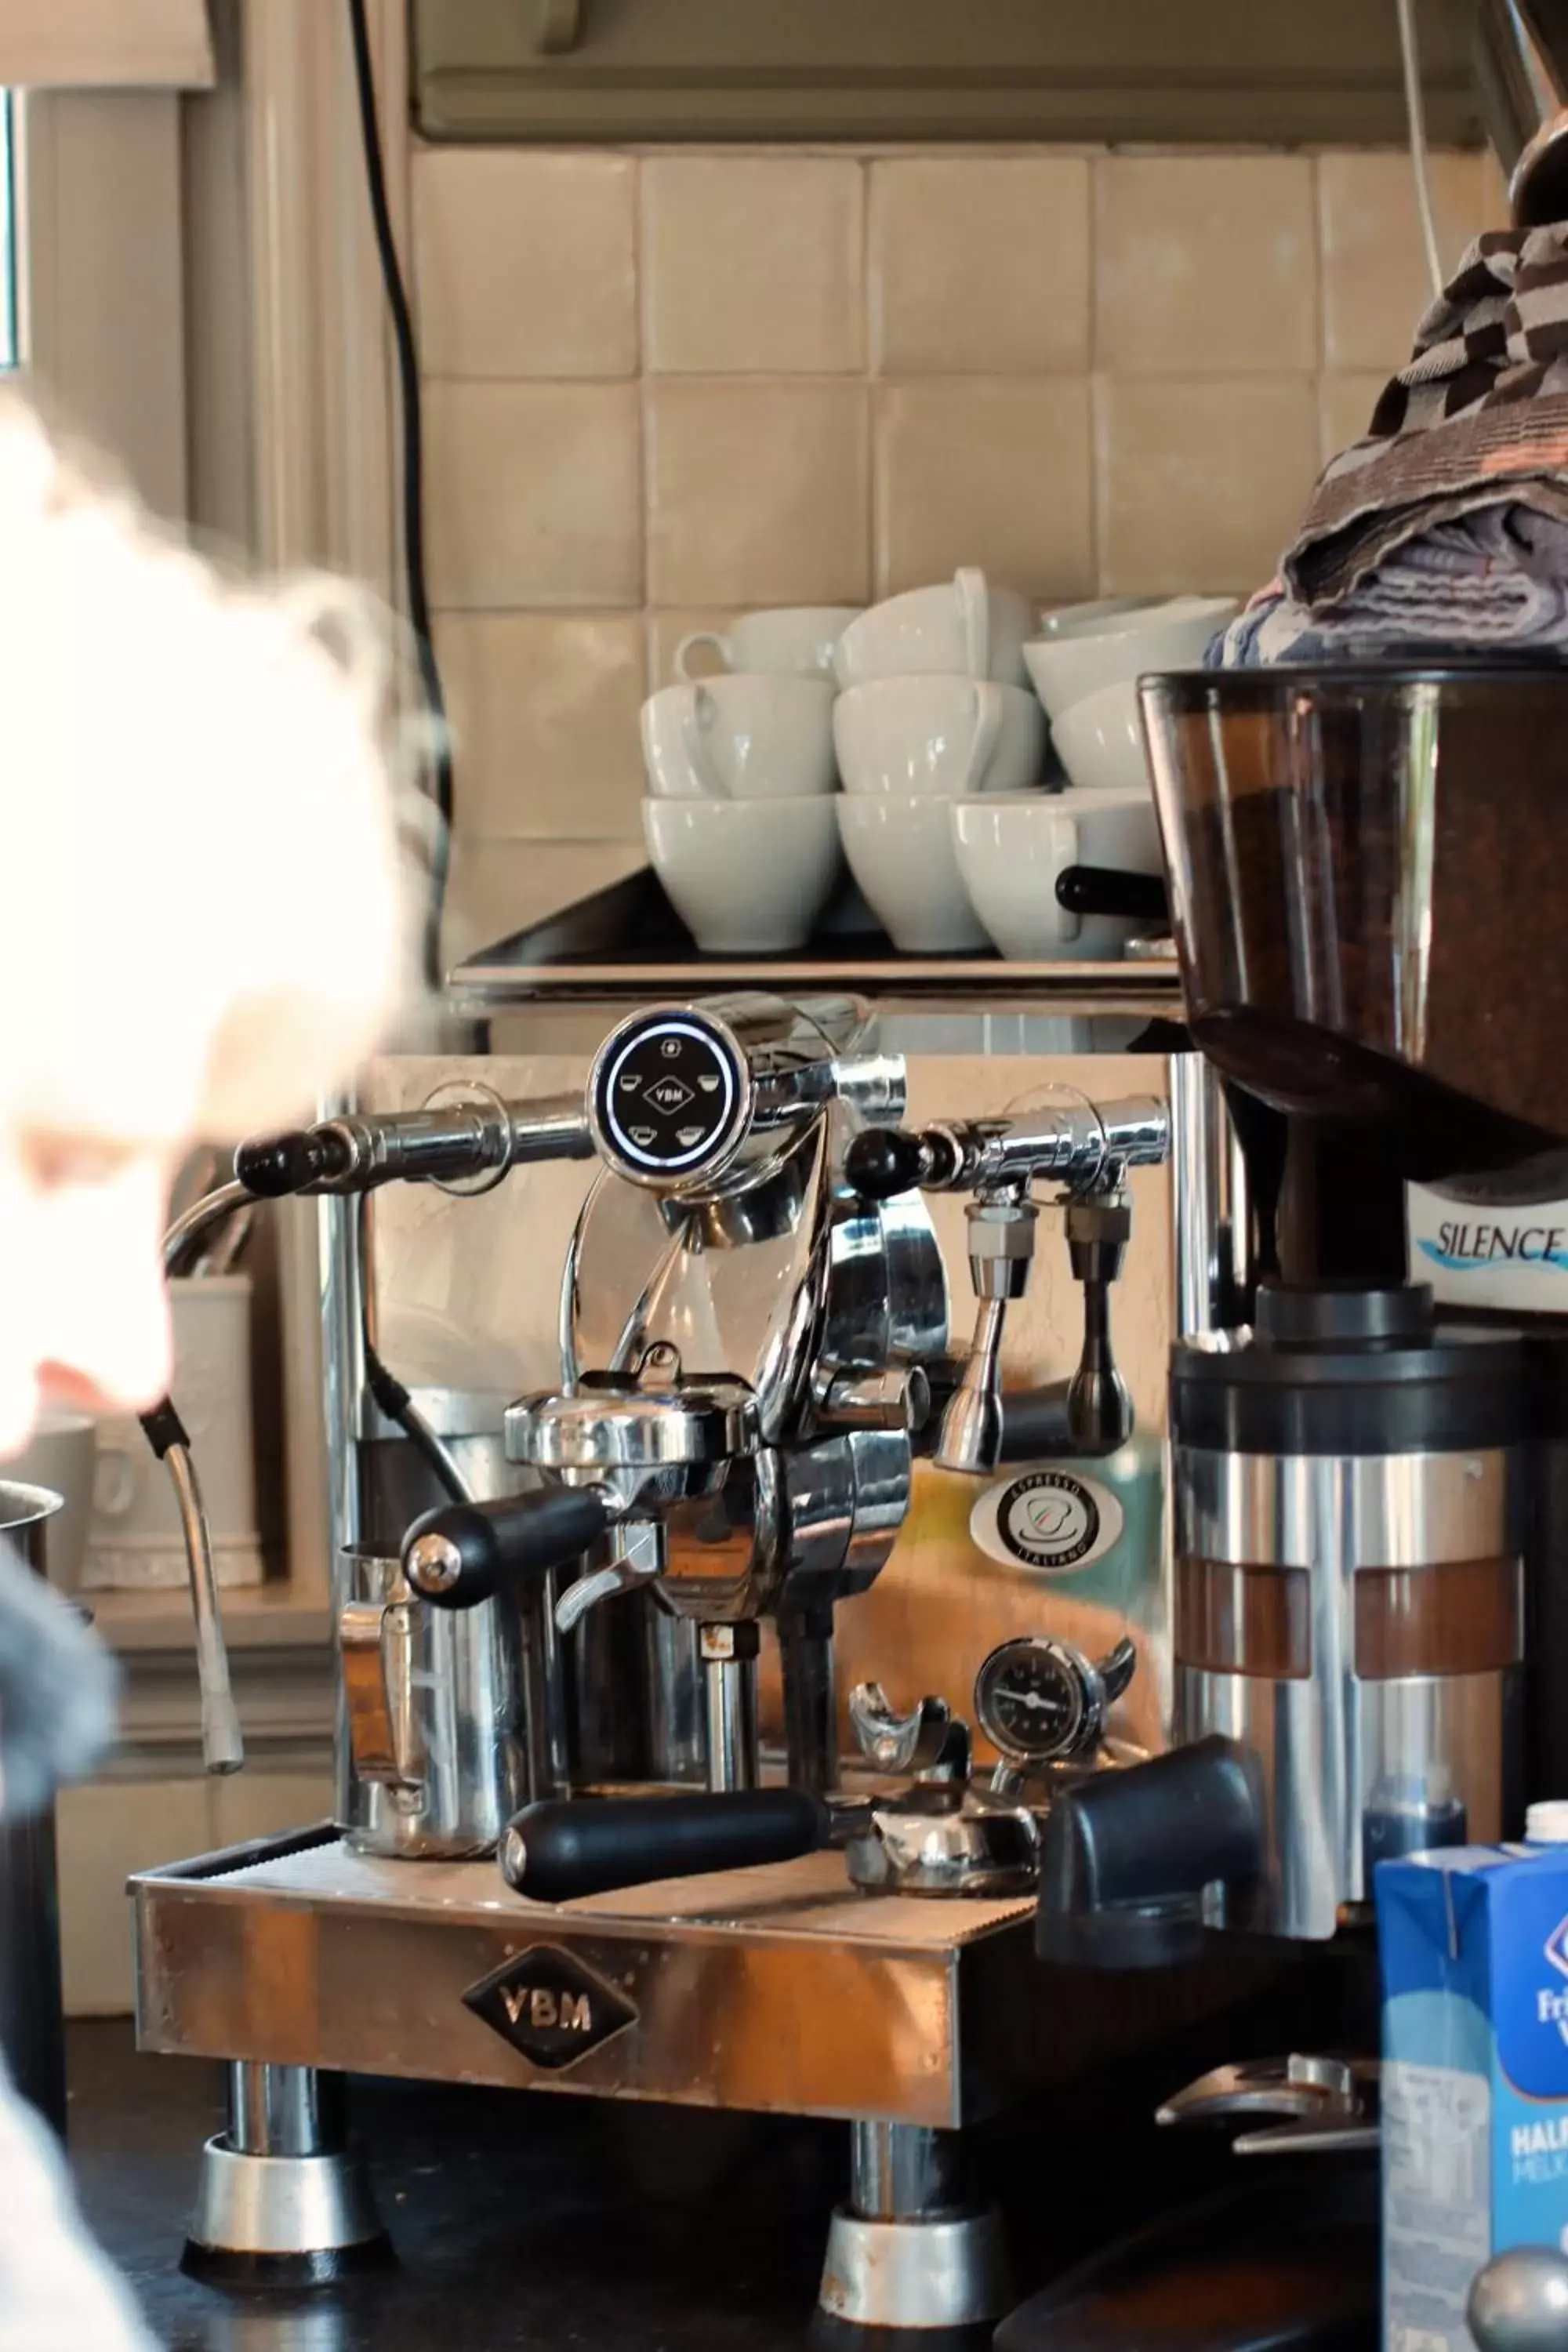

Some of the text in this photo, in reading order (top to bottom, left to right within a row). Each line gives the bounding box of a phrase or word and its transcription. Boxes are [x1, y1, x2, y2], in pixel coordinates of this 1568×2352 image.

[655, 1088, 683, 1102] VBM
[1437, 1221, 1566, 1262] SILENCE
[1011, 1474, 1080, 1498] ESPRESSO
[1018, 1542, 1087, 1565] ITALIANO
[499, 1984, 592, 2031] VBM
